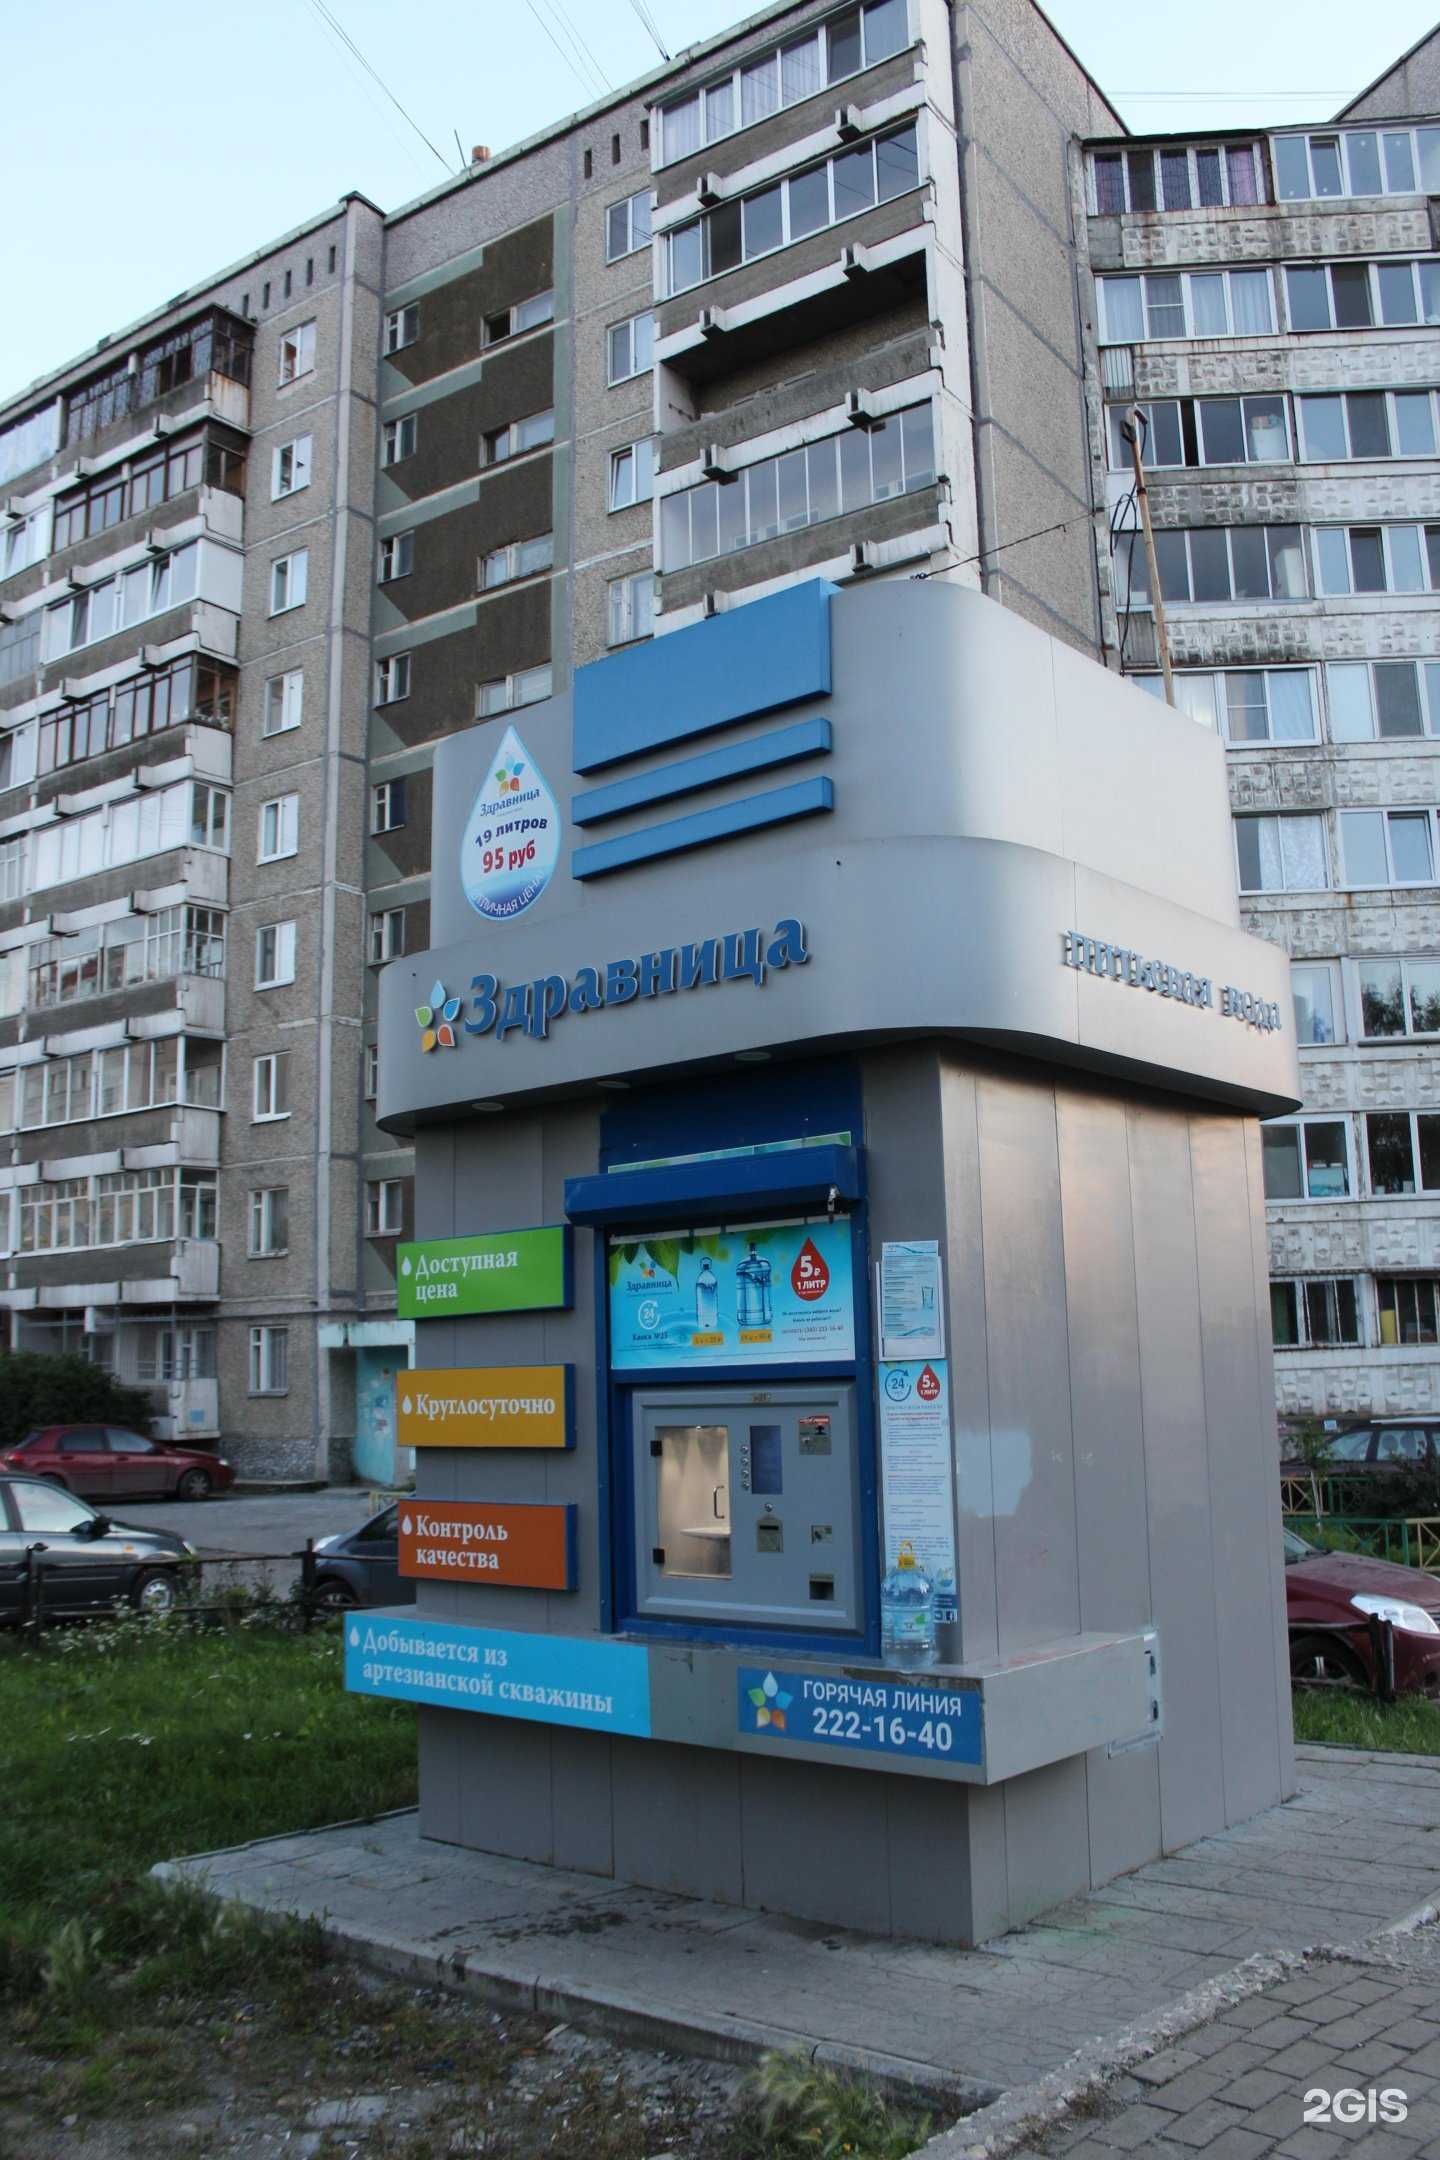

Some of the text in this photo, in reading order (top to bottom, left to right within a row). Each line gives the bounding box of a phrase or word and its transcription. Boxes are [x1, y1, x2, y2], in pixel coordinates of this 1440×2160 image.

[479, 788, 541, 817] Здравница
[474, 816, 548, 849] 19 литров
[482, 839, 536, 874] 95 руб
[464, 917, 811, 1042] Здравница
[415, 1250, 519, 1281] Доступная
[415, 1282, 458, 1304] цена
[803, 1279, 826, 1290] ЛИТР
[891, 1377, 905, 1390] 24
[415, 1393, 556, 1421] Круглосуточно
[415, 1514, 509, 1545] Контроль
[415, 1547, 500, 1570] качества
[362, 1627, 509, 1667] Добывается из
[363, 1663, 615, 1715] артезианской скважины
[803, 1680, 962, 1718] ГОРЯЧАЯ ЛИНИЯ
[812, 1706, 953, 1752] 222-16-40
